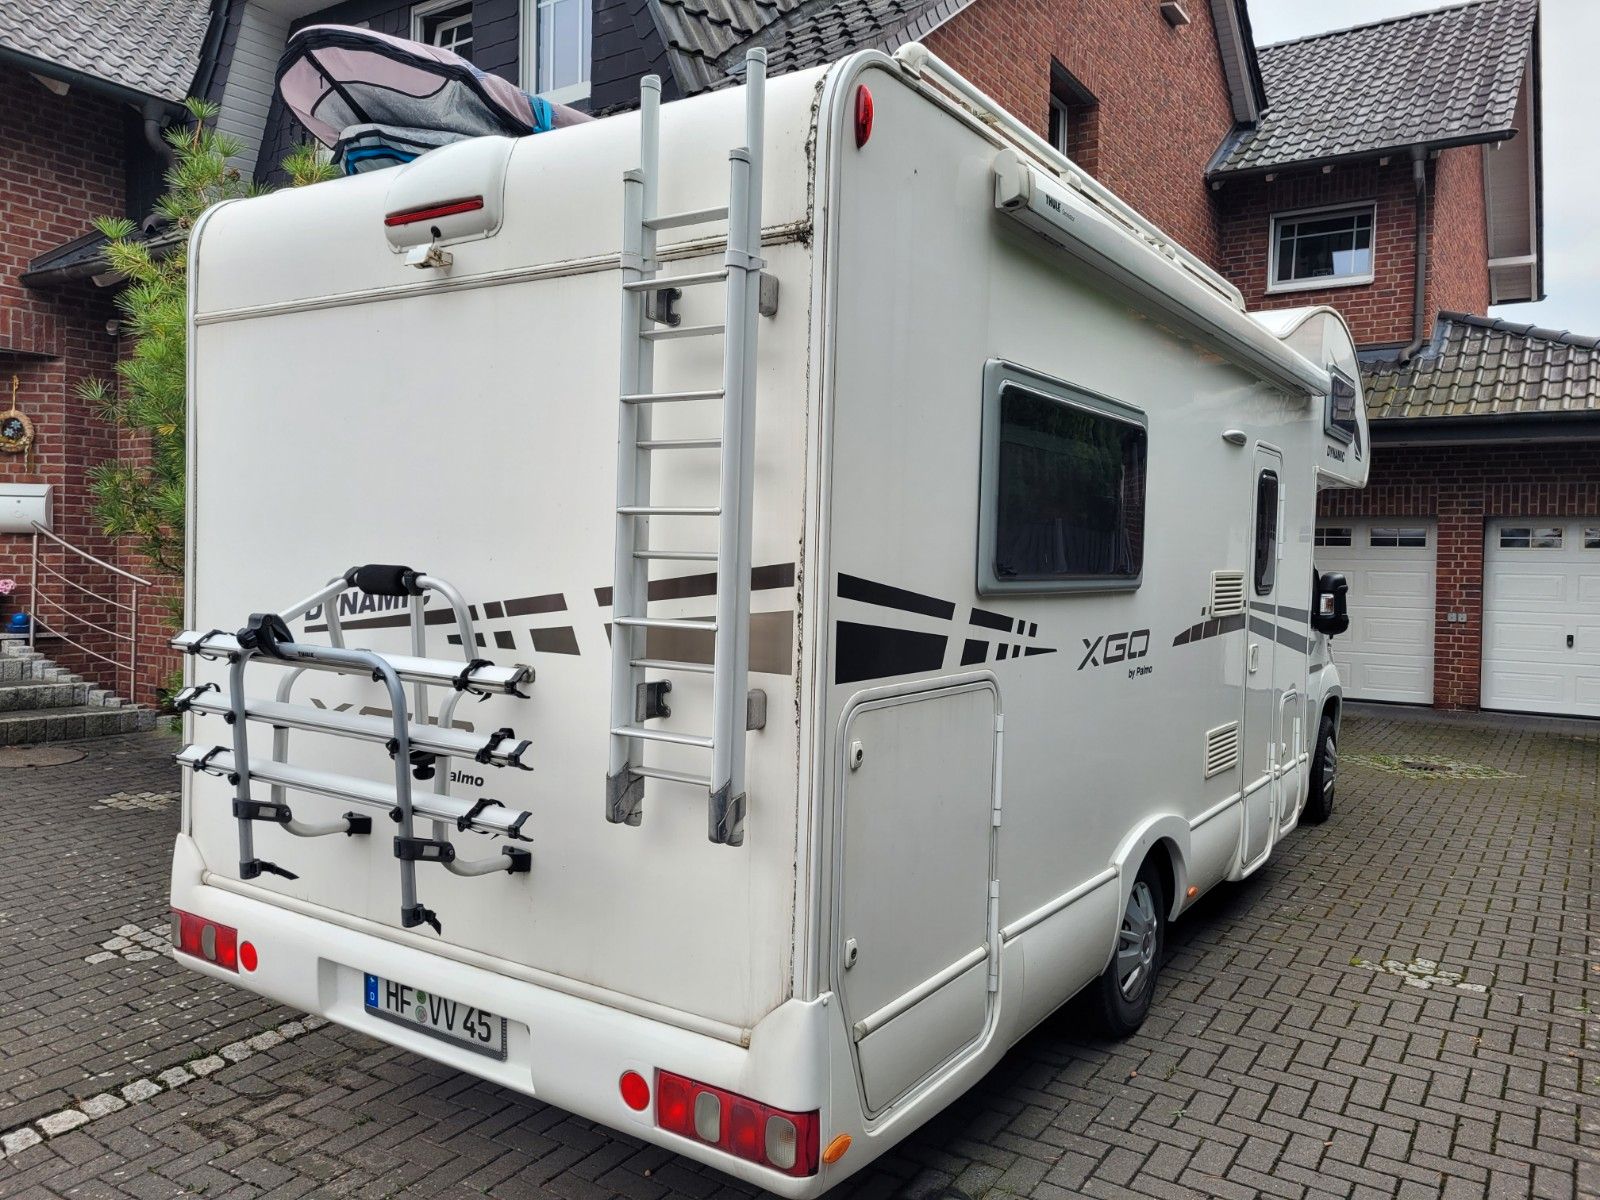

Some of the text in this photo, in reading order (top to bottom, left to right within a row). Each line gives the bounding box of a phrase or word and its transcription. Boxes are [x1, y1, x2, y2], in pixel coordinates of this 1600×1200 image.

[1327, 445, 1346, 463] DYNAMIC
[1077, 629, 1150, 671] XGO
[1128, 665, 1152, 680] by Palmo
[450, 770, 485, 787] almo
[386, 979, 413, 1014] HF
[463, 1006, 492, 1043] 45
